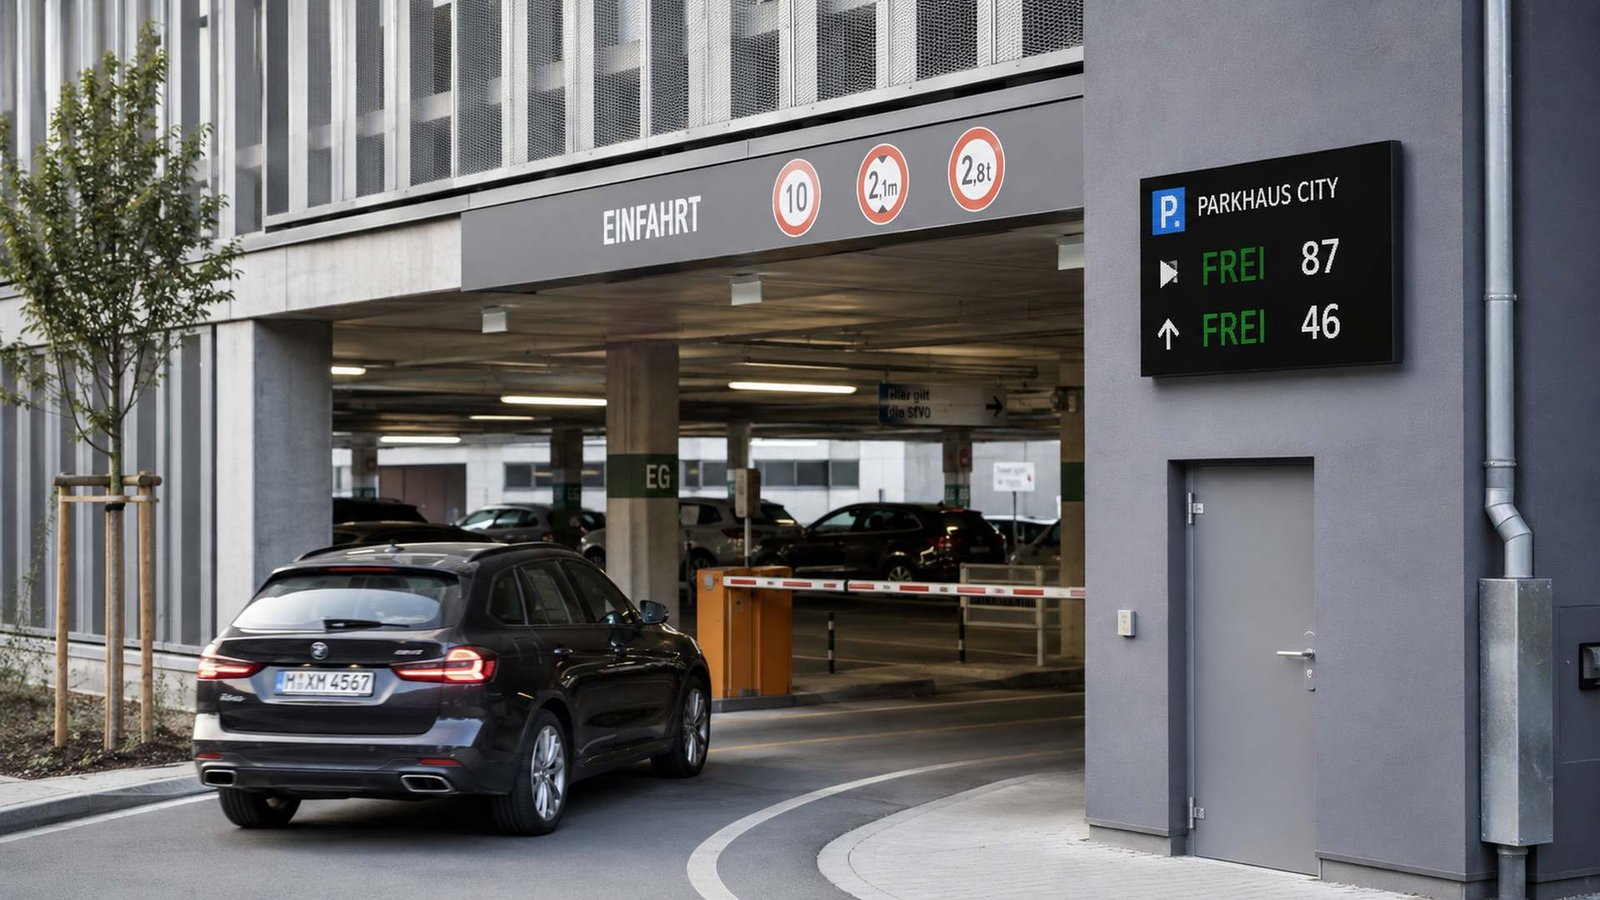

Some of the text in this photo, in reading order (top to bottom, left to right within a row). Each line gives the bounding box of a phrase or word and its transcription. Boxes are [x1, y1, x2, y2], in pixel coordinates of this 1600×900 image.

[868, 170, 898, 201] 2,1m
[961, 154, 992, 187] 2,8t
[786, 181, 808, 213] 10
[1198, 177, 1339, 217] PARKHAUS CITY
[603, 195, 702, 246] EINFAHRT
[1203, 238, 1340, 286] FREI 87
[1203, 303, 1341, 347] FREI 46
[645, 464, 671, 489] EG
[330, 674, 370, 691] 4567
